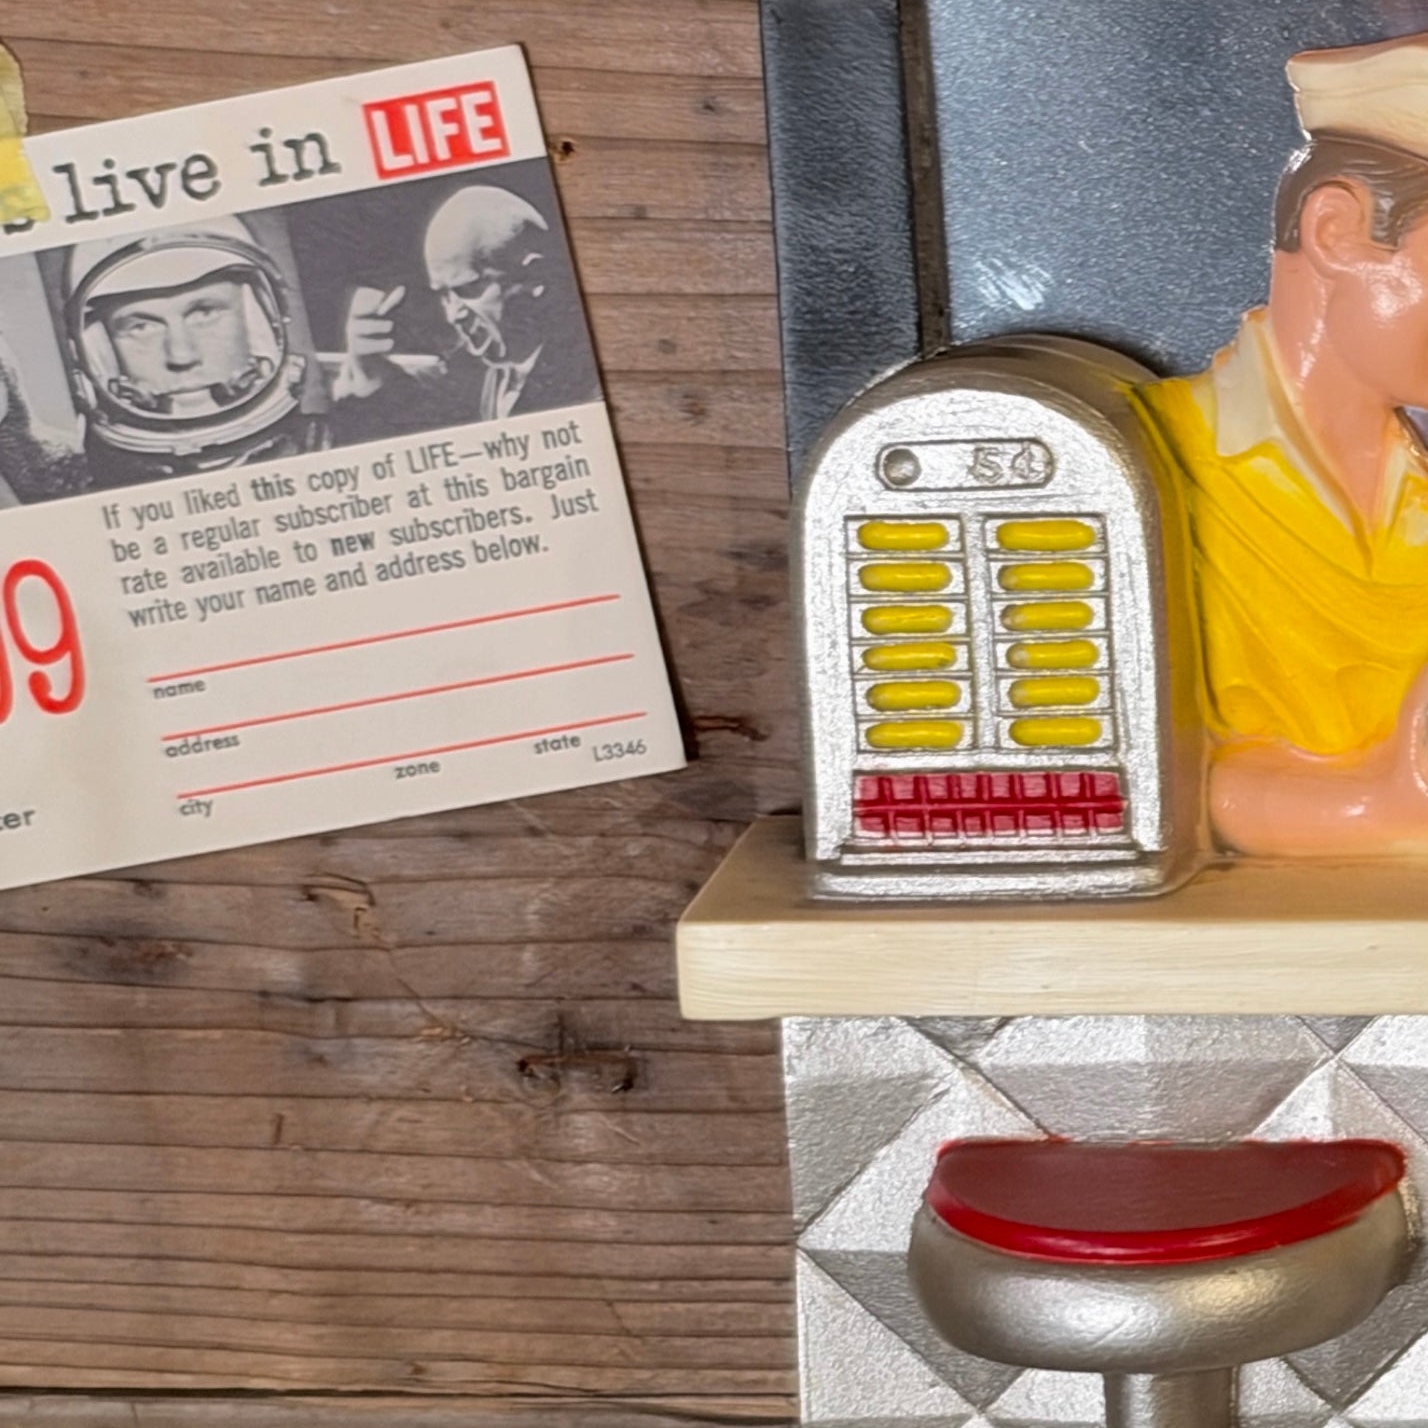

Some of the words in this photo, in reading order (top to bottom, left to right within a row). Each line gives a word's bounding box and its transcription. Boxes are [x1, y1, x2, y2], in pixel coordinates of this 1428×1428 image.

[52, 152, 222, 224] live
[250, 127, 342, 187] in
[371, 90, 502, 172] LIFE
[101, 504, 121, 529] If
[132, 499, 174, 531] you
[183, 483, 241, 515] liked
[250, 473, 297, 502] this
[307, 464, 360, 493] copy
[372, 452, 396, 480] of
[542, 420, 582, 450] not
[110, 539, 141, 563] be
[153, 536, 168, 555] a
[180, 517, 262, 551] regular
[275, 493, 394, 533] subscriber
[407, 483, 432, 509] at
[444, 472, 489, 503] this
[501, 454, 591, 491] bargain
[120, 569, 168, 595] rate
[182, 545, 281, 585] available
[294, 539, 318, 564] to
[330, 530, 376, 558] new
[389, 503, 533, 547] subscribers.
[551, 487, 600, 520] Just
[128, 599, 188, 628] write
[195, 590, 246, 622] your
[256, 575, 317, 606] name
[325, 561, 368, 593] and
[376, 548, 467, 582] address
[472, 532, 550, 564] below.
[0, 558, 85, 723] 9
[153, 679, 206, 699] name
[165, 733, 240, 758] address
[394, 759, 441, 779] zone
[533, 733, 582, 754] state
[592, 739, 647, 763] L3346
[179, 798, 215, 818] city
